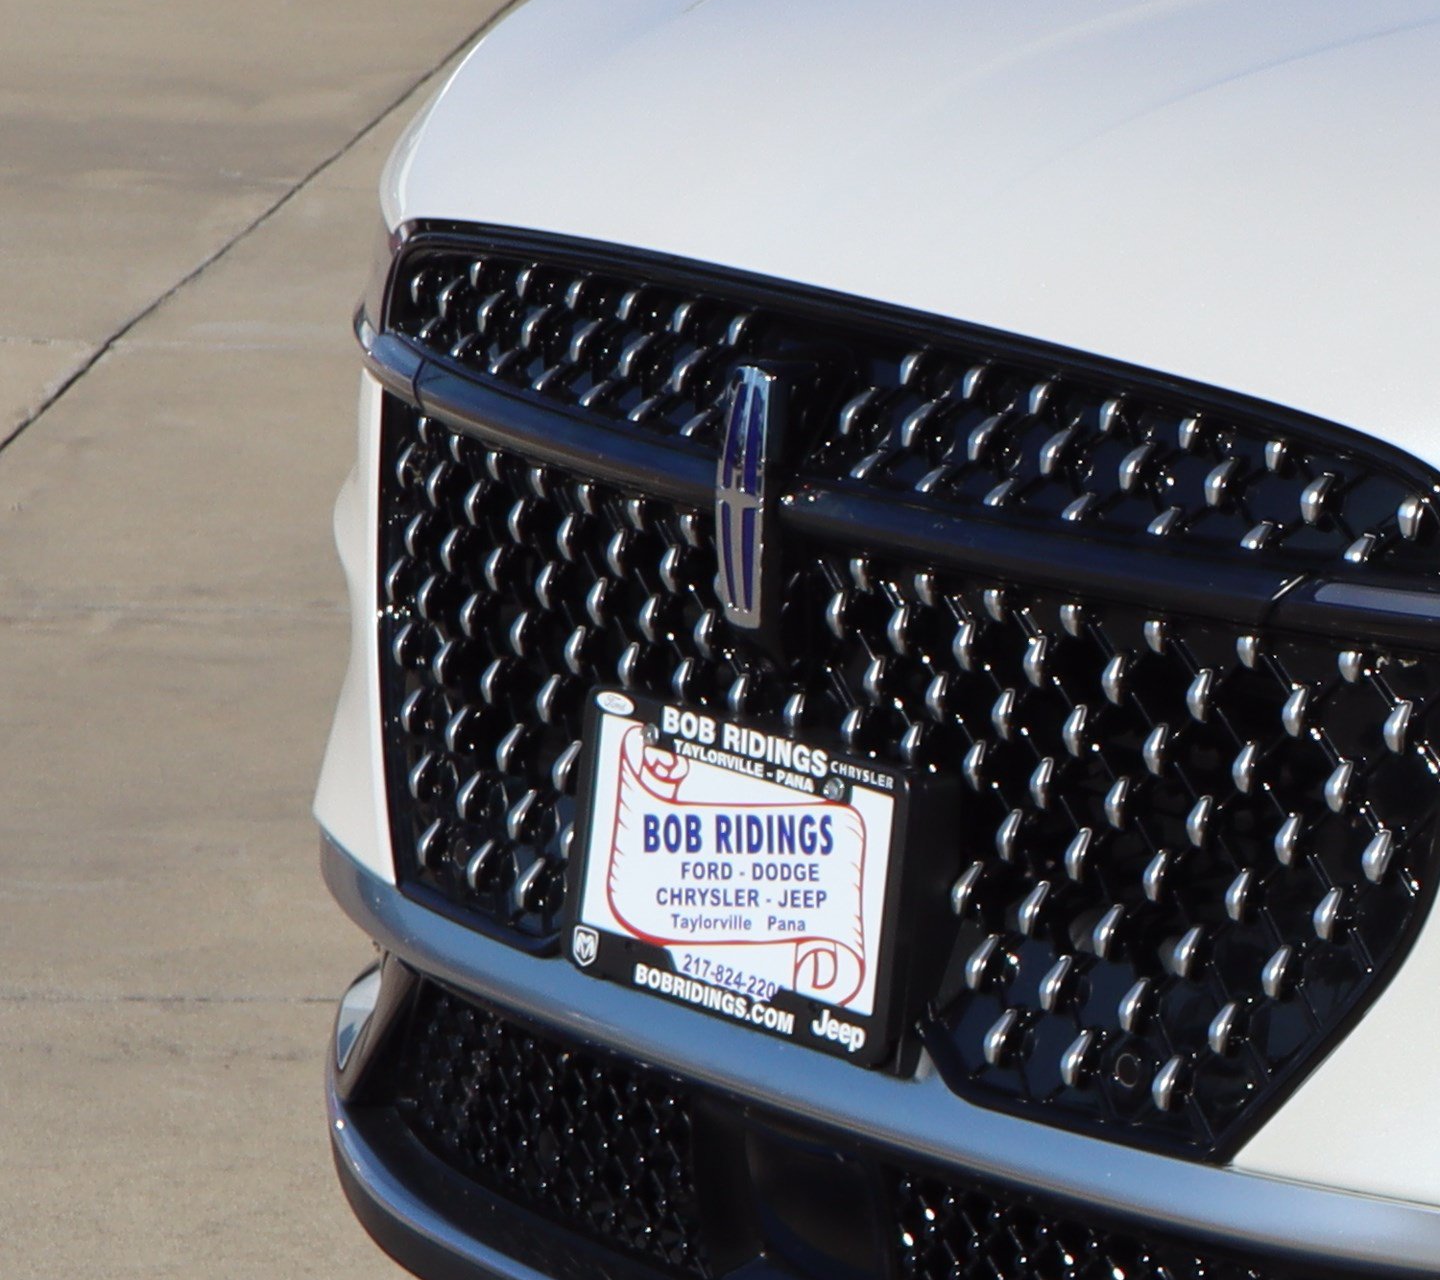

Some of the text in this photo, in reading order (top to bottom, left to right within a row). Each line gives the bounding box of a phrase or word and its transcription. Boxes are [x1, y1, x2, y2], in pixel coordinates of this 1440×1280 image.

[662, 705, 894, 790] BOB RIDINGS CHRYSLER
[673, 738, 764, 778] TAYLORVILLE
[776, 769, 815, 794] PANA
[643, 813, 834, 856] BOB RIDINGS
[681, 861, 733, 881] FORD
[752, 862, 820, 882] DODGE
[656, 887, 759, 908] CHRYSLER
[778, 889, 827, 909] JEEP
[671, 913, 806, 933] Taylorville Pana
[682, 952, 783, 1000] 217-824-220
[634, 963, 795, 1035] BOBRIDINGS.COM
[812, 1009, 866, 1053] Jeep
